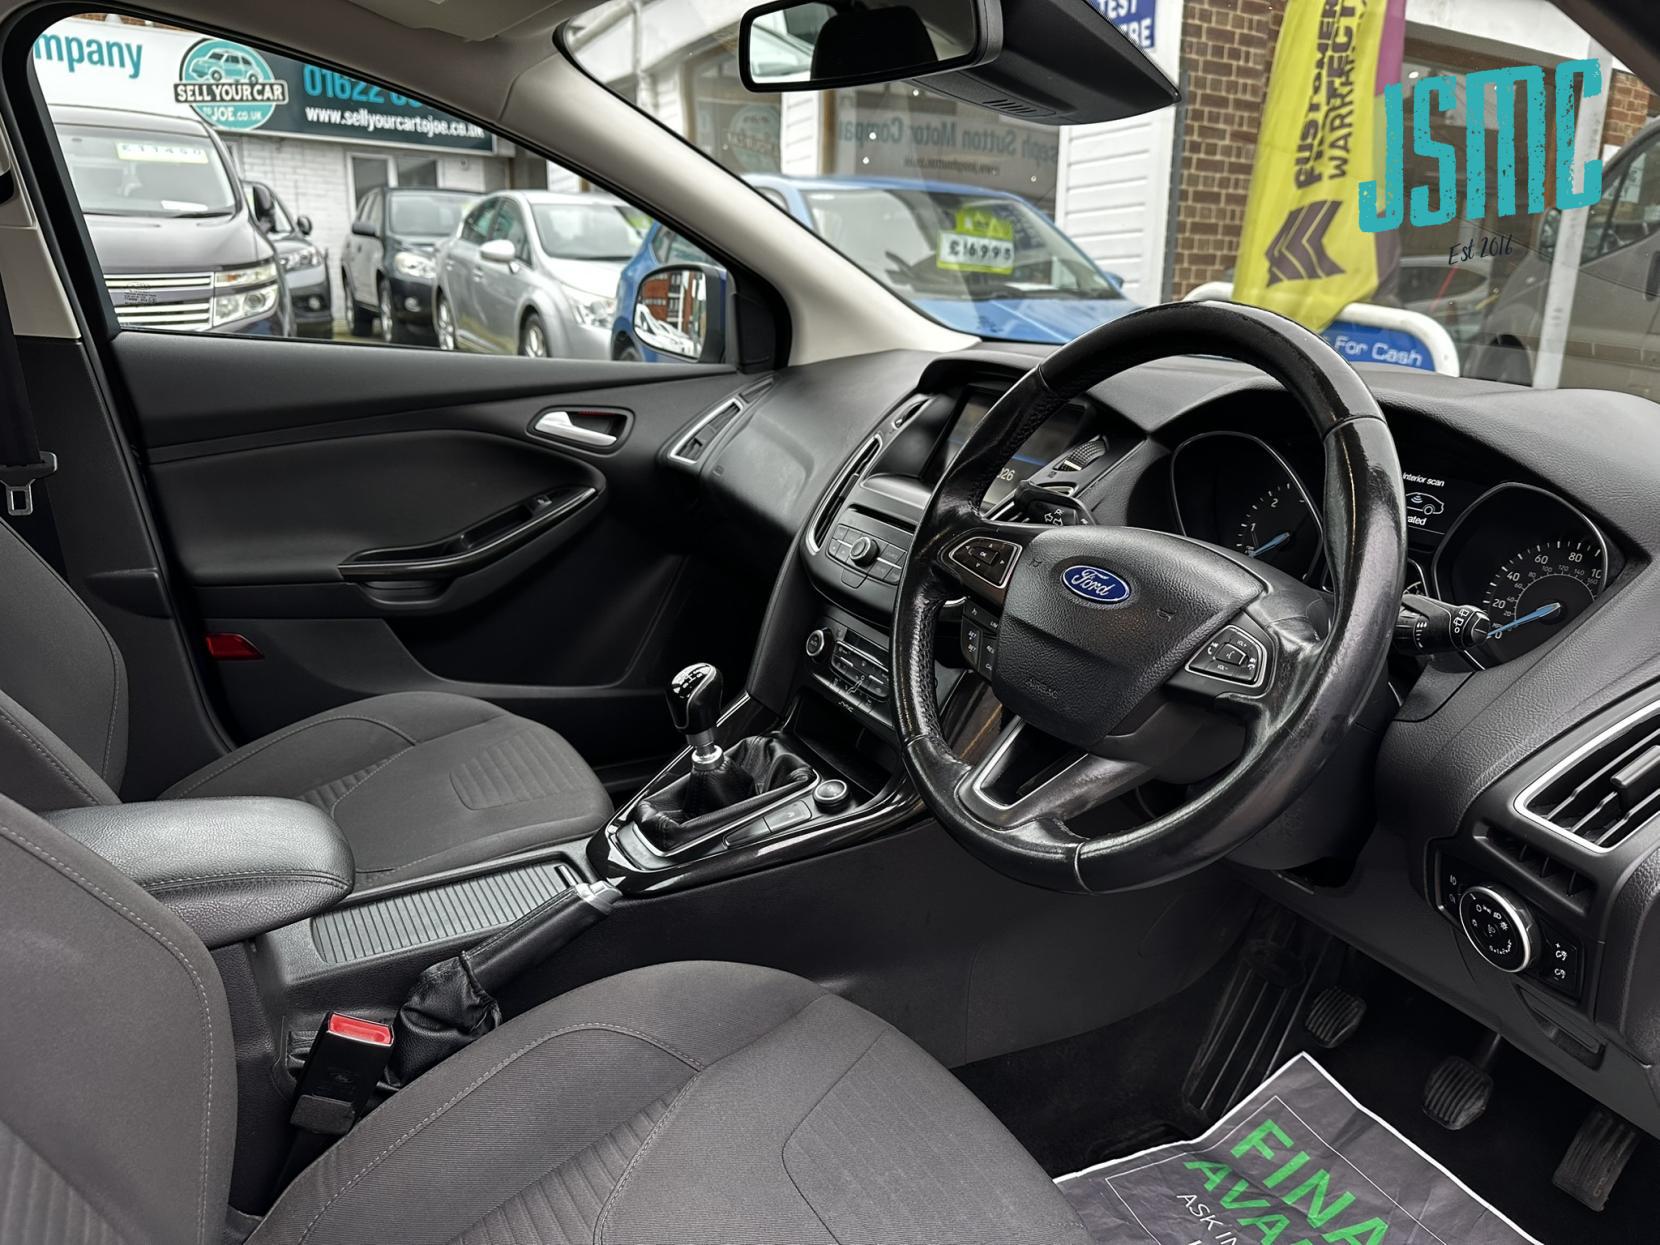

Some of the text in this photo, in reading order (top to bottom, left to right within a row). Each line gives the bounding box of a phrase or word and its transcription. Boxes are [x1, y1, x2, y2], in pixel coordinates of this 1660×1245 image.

[177, 84, 283, 101] SELL YOUR CAR
[1335, 336, 1368, 355] For
[1371, 342, 1423, 366] Cash
[1427, 479, 1445, 487] scan
[1271, 498, 1278, 508] 2
[1535, 554, 1549, 564] 60
[1568, 552, 1583, 563] 80
[1071, 568, 1116, 596] Ford
[1507, 572, 1520, 581] 40
[1493, 598, 1506, 609] 20
[1177, 1193, 1224, 1231] ASK
